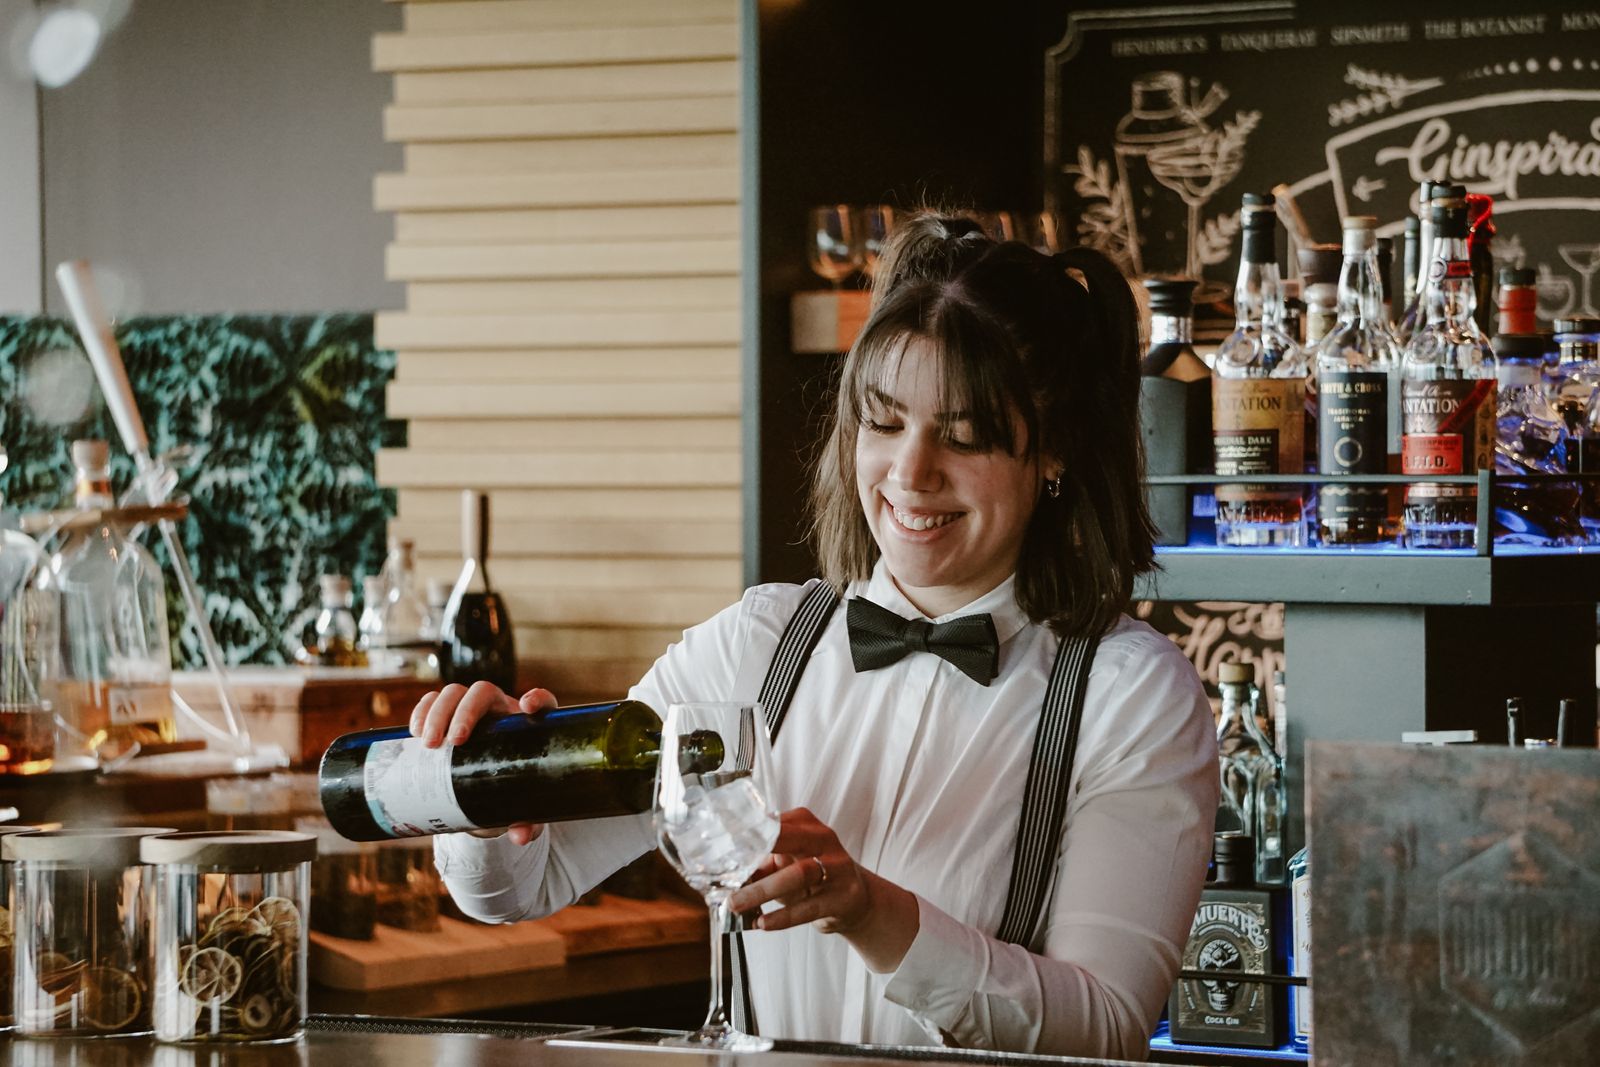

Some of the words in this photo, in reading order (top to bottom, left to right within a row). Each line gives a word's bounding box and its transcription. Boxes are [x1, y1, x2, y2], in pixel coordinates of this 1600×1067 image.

[1425, 19, 1457, 40] THE
[1460, 14, 1544, 37] BOTANIST
[1354, 382, 1382, 393] CROSS
[1246, 435, 1272, 446] DARK
